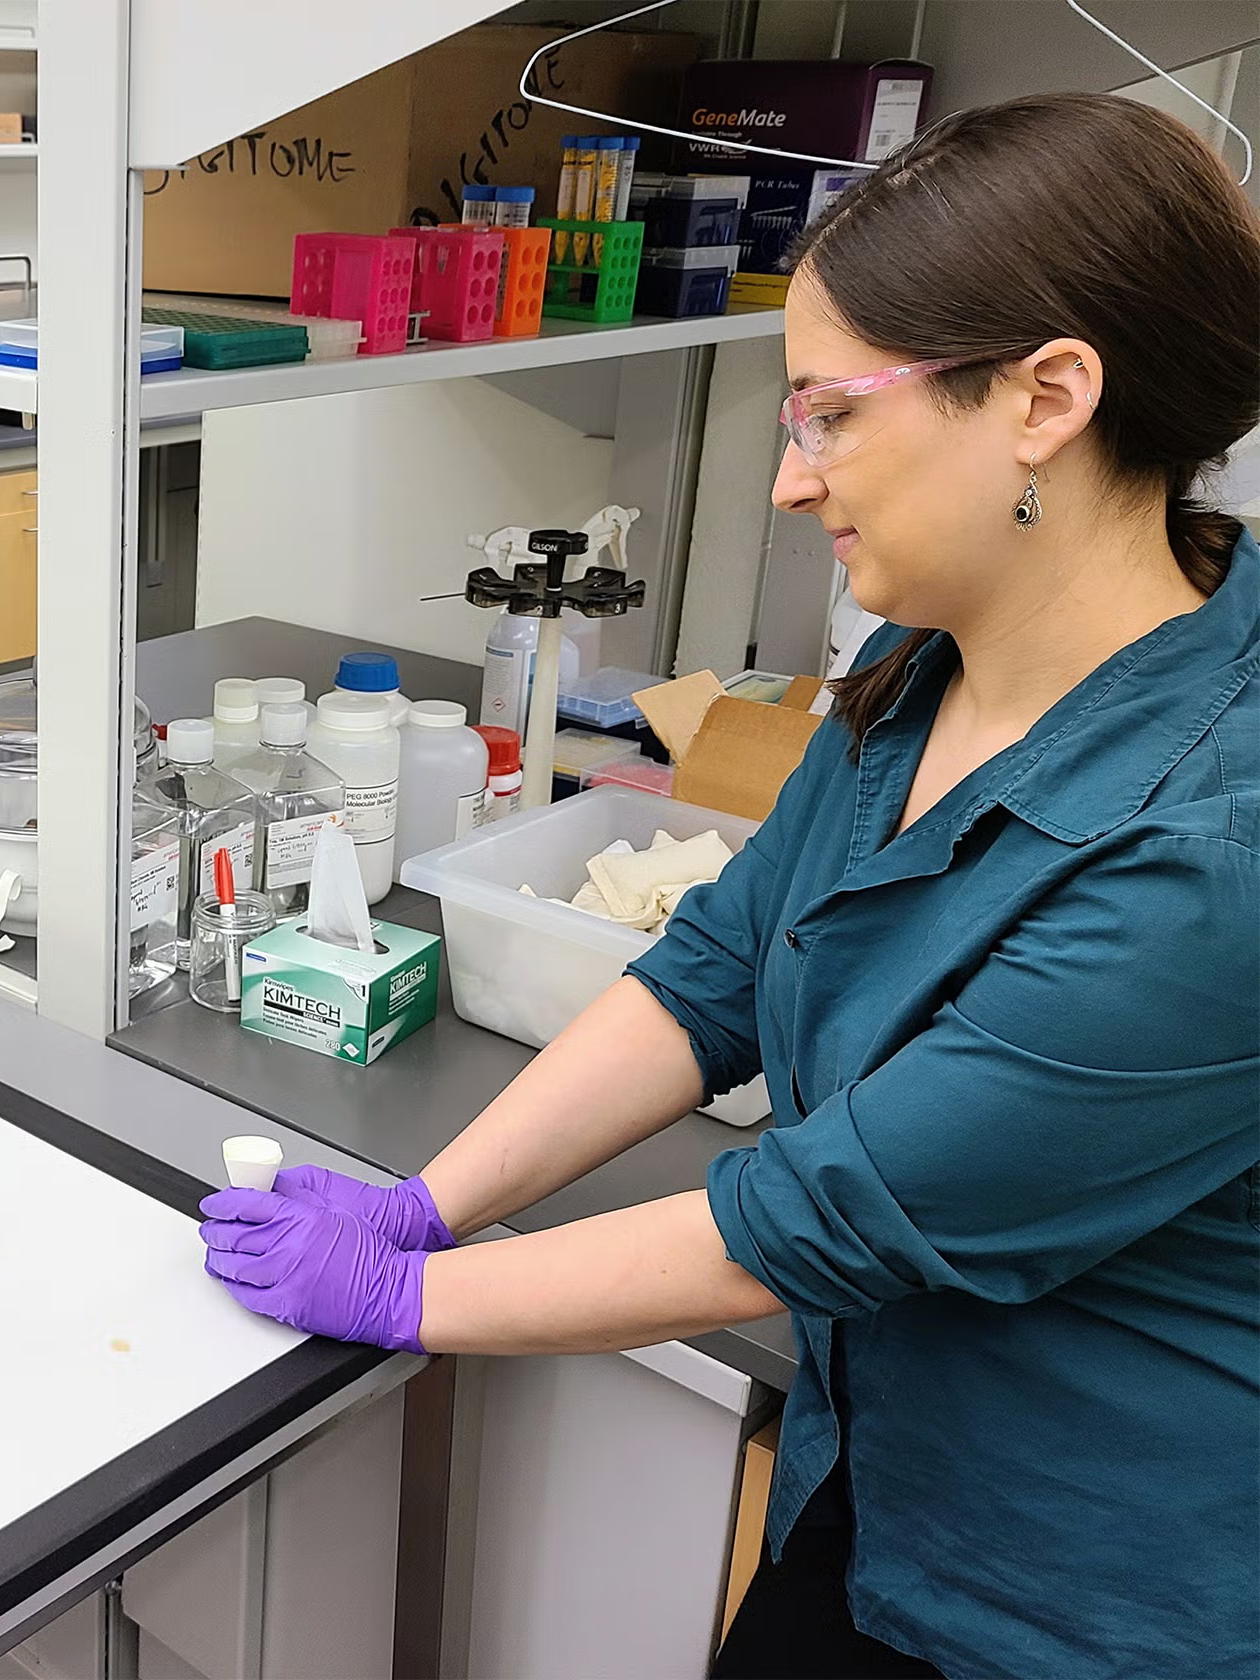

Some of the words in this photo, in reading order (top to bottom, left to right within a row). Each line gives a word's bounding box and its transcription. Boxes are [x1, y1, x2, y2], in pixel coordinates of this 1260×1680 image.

[692, 108, 787, 127] GeneMate
[143, 131, 357, 195] GITOME
[755, 180, 774, 189] PCR
[777, 180, 801, 190] Tubes
[531, 542, 559, 552] GILSON
[614, 602, 622, 614] 3
[264, 977, 295, 992] Kimwipes
[390, 961, 427, 995] KIMTECH
[264, 985, 341, 1021] KIMTECH
